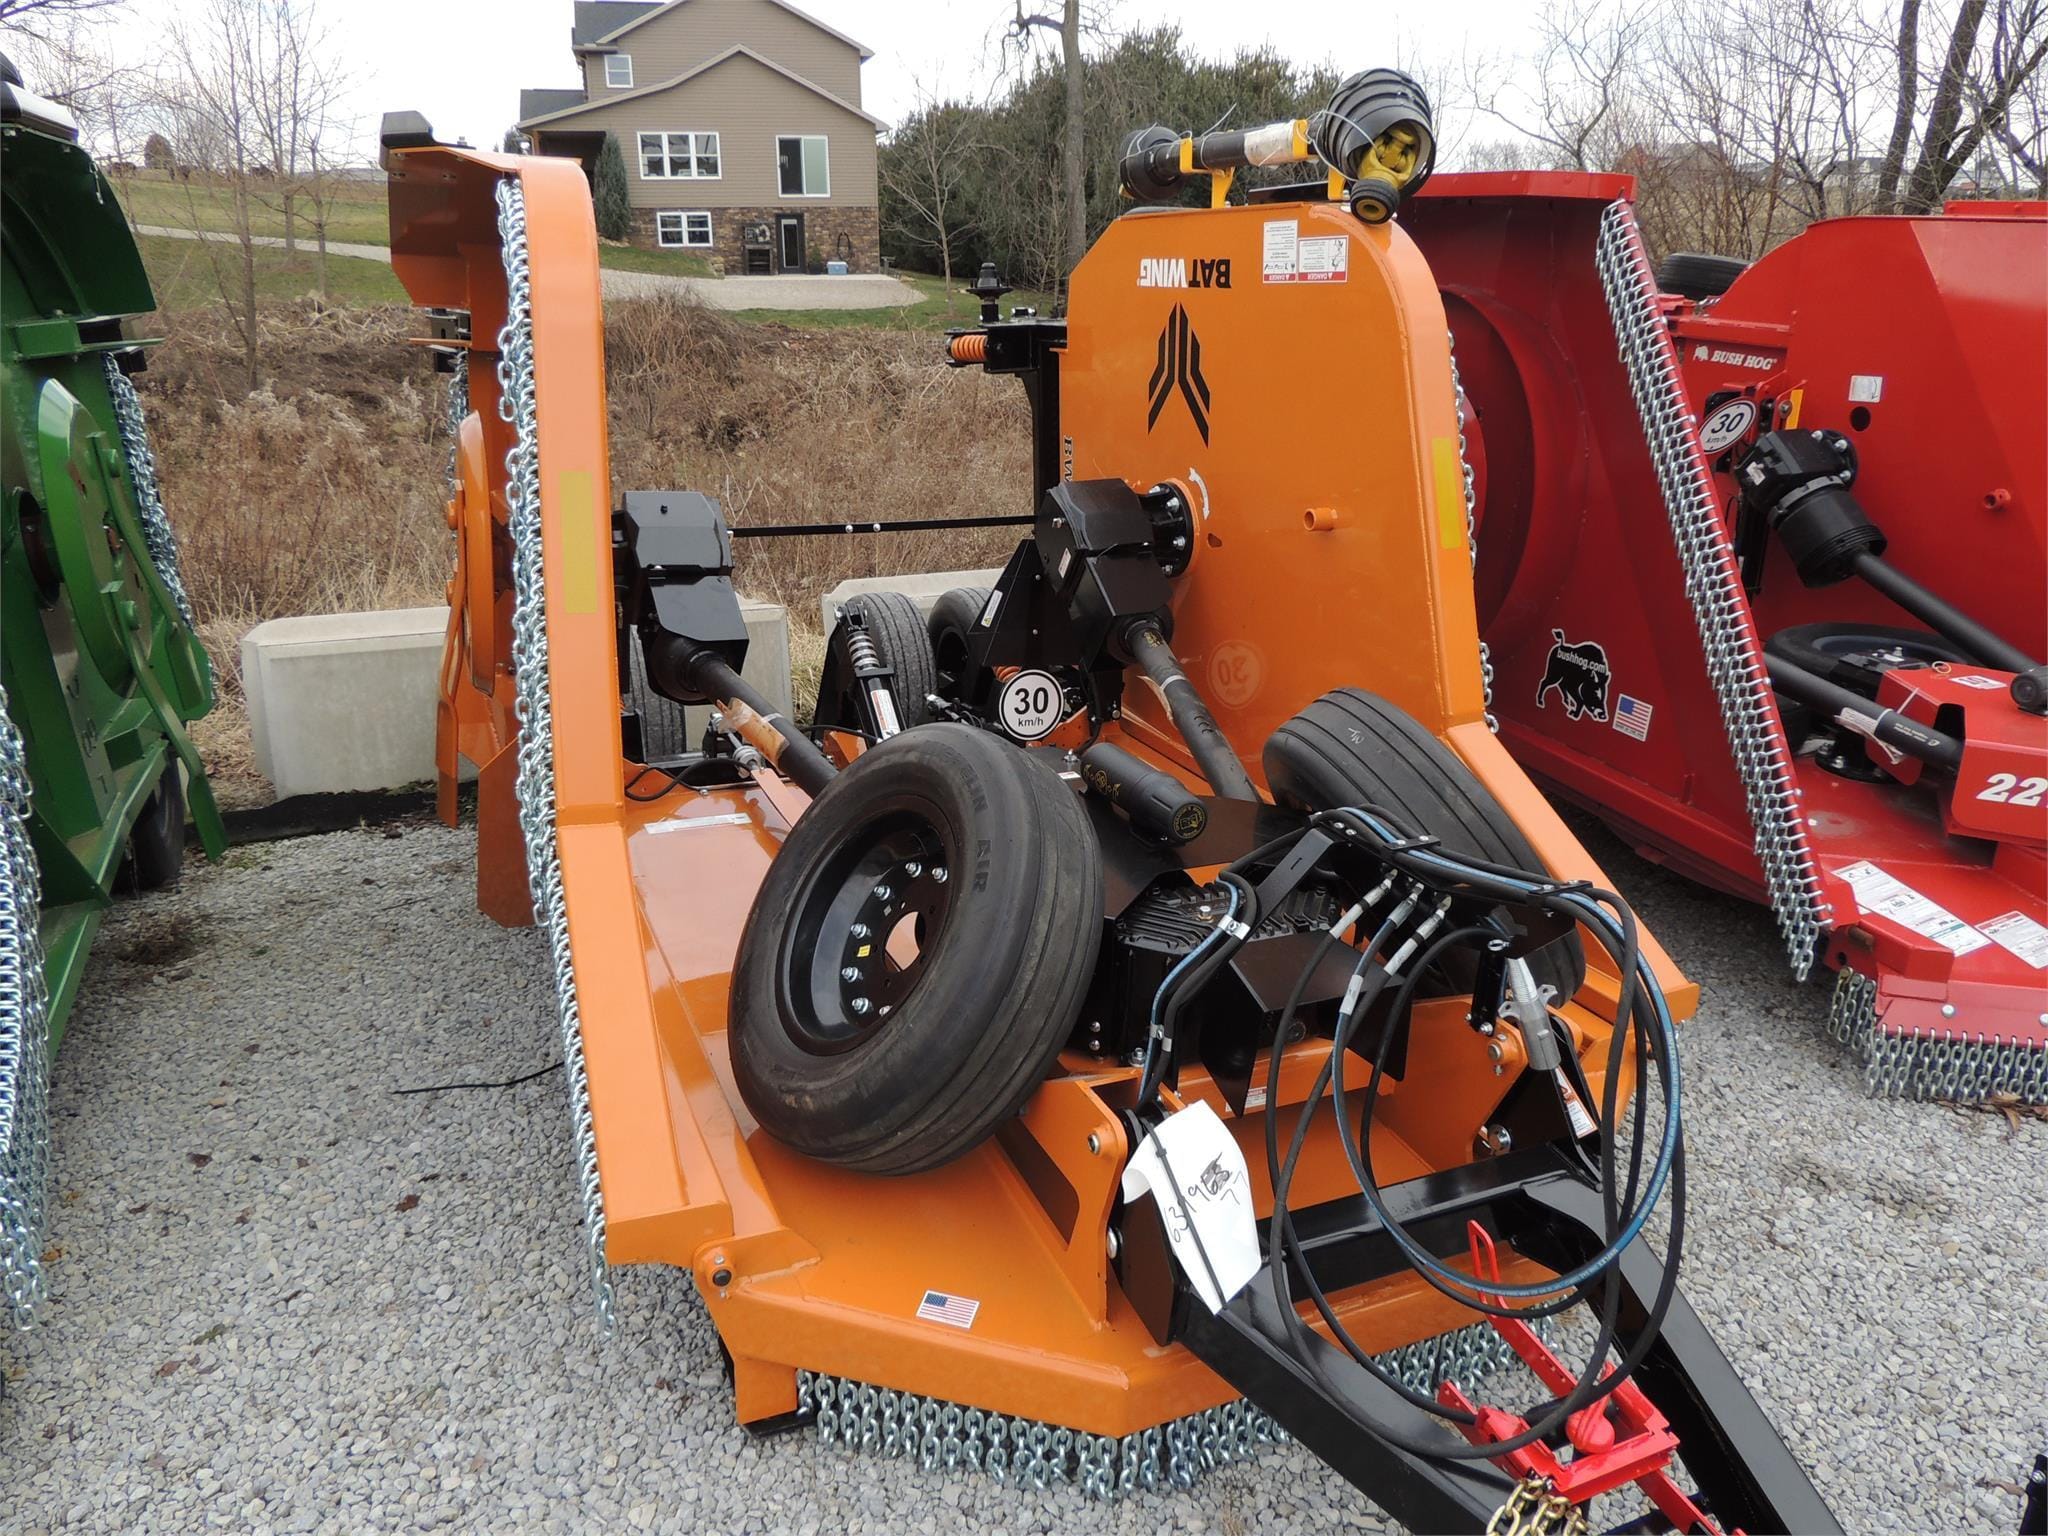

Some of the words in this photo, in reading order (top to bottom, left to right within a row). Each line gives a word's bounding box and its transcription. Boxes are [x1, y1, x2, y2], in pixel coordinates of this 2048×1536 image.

[1711, 350, 1745, 366] BUSH
[1744, 355, 1773, 371] HOG
[1711, 412, 1745, 434] 30
[1557, 647, 1605, 674] bushhog.com
[1014, 687, 1049, 715] 30
[1018, 718, 1044, 727] km/h
